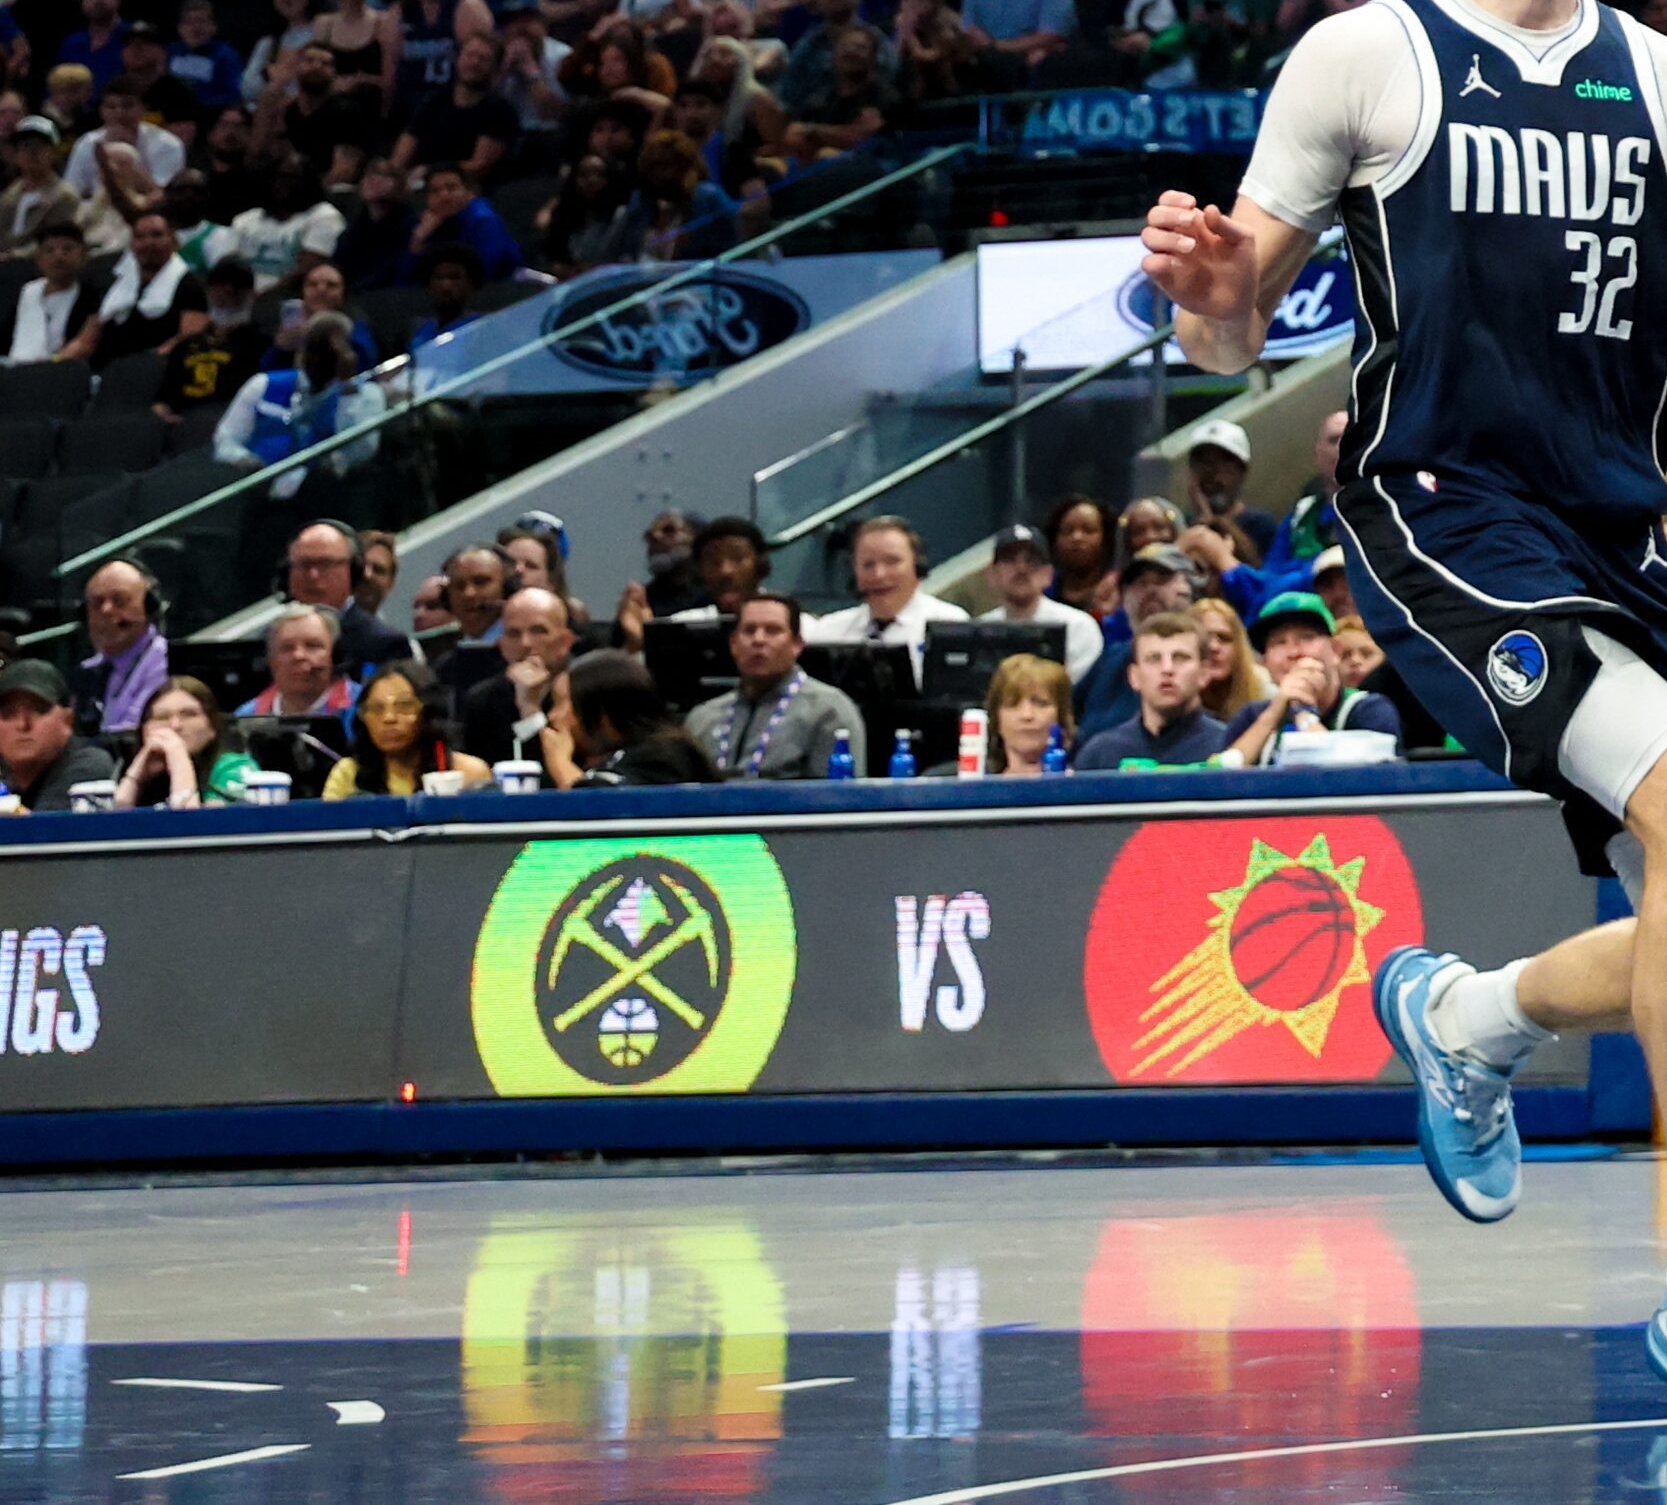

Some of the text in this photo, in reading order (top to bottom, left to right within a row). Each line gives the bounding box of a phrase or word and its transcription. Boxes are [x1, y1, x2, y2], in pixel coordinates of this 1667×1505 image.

[1575, 79, 1632, 102] chime
[1448, 123, 1650, 226] MAVS
[1558, 230, 1637, 341] 32
[894, 891, 992, 1033] VS
